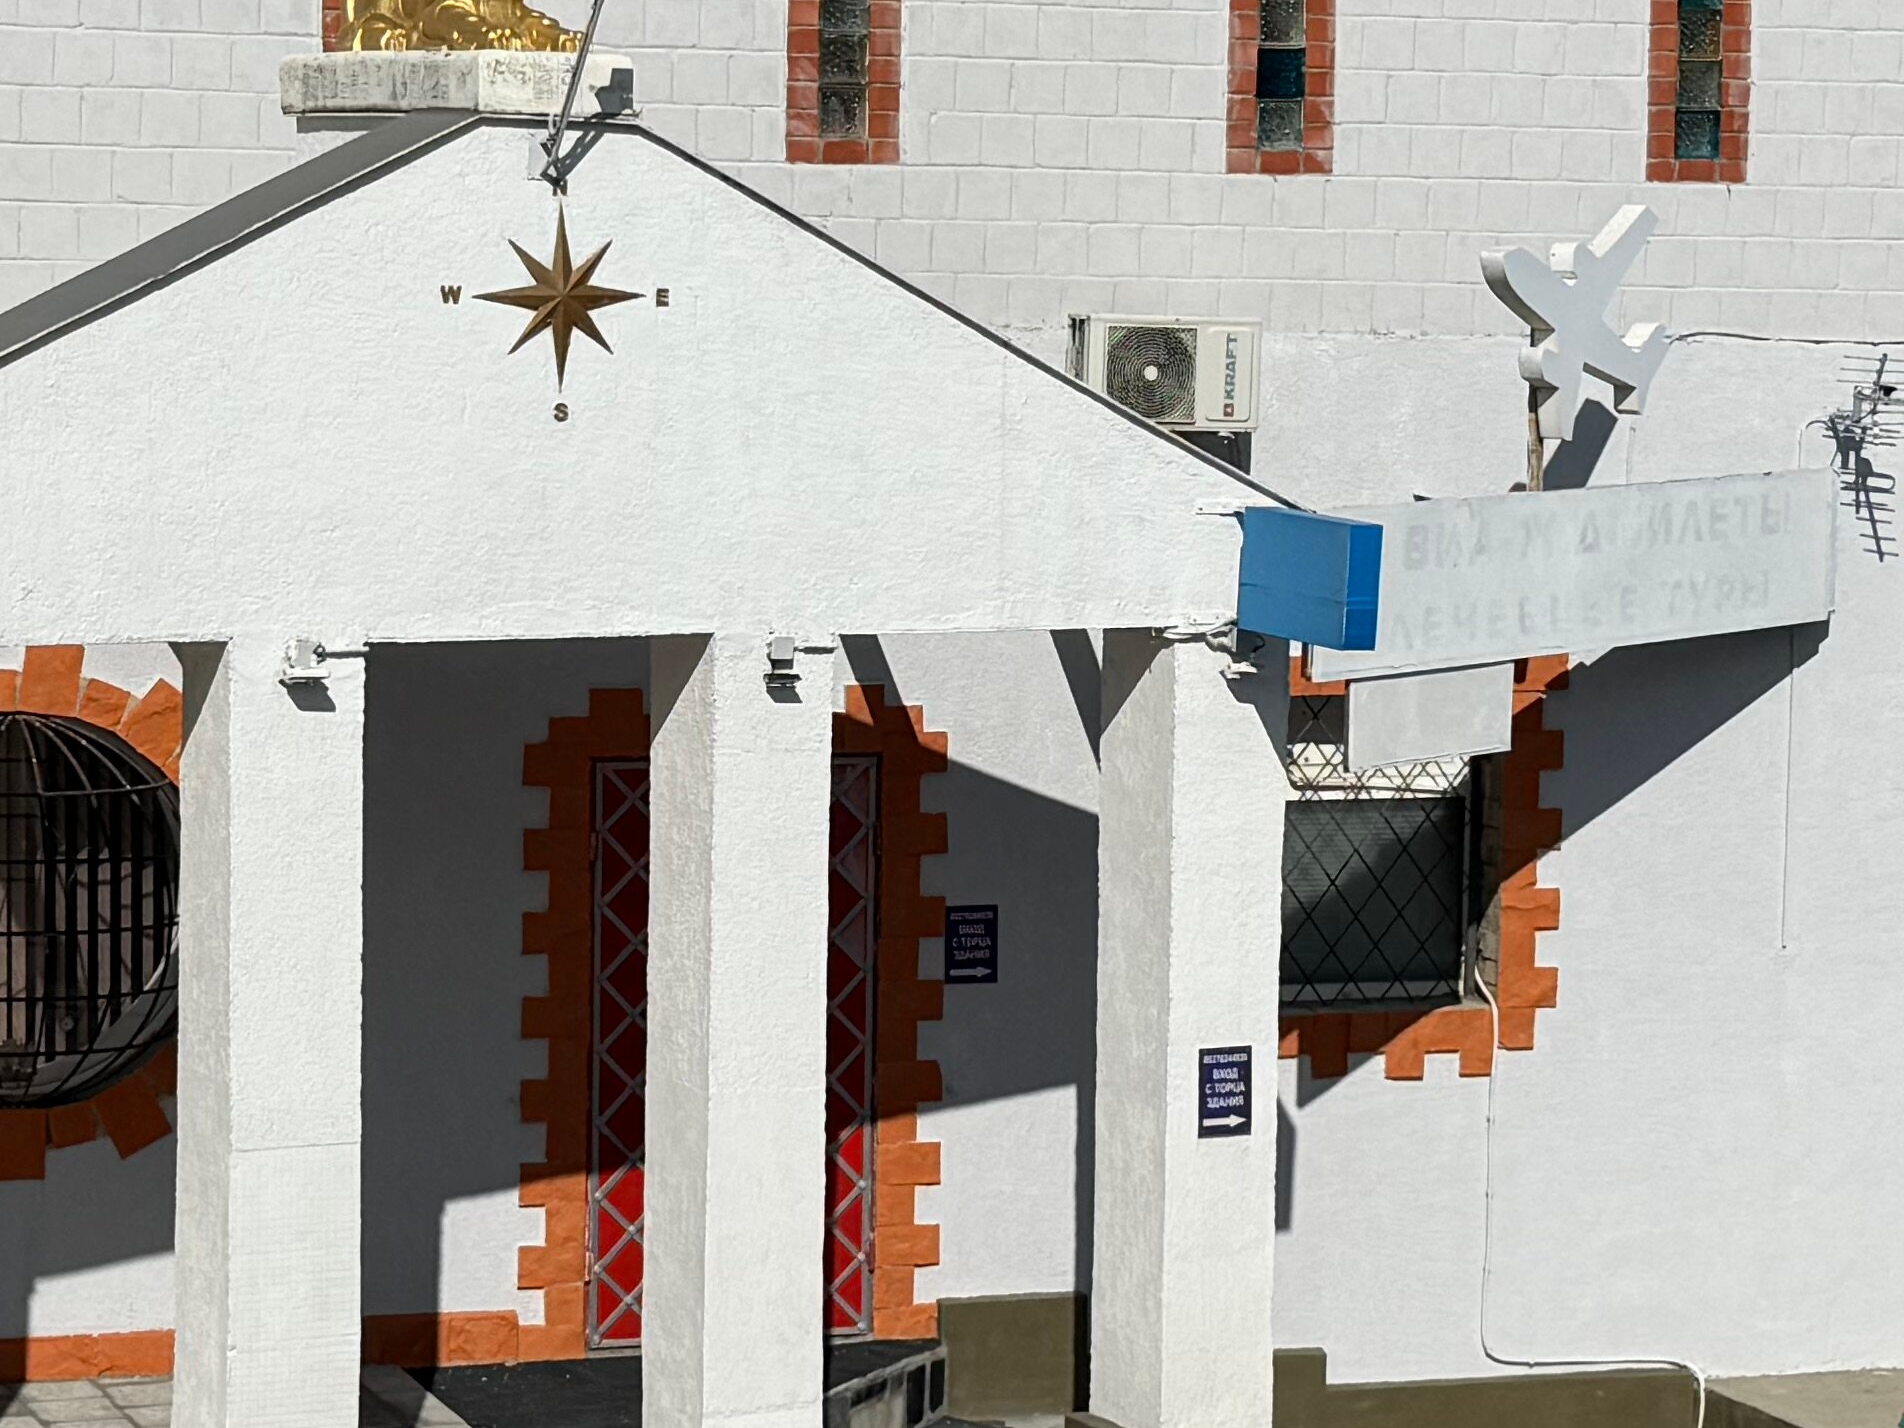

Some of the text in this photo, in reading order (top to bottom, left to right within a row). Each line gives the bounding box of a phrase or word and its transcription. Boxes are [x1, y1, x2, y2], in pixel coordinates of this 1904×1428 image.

[440, 284, 463, 305] W
[656, 288, 670, 307] E
[1223, 332, 1238, 401] KRAFT
[552, 403, 569, 423] S
[1213, 1067, 1238, 1079] ВХОД
